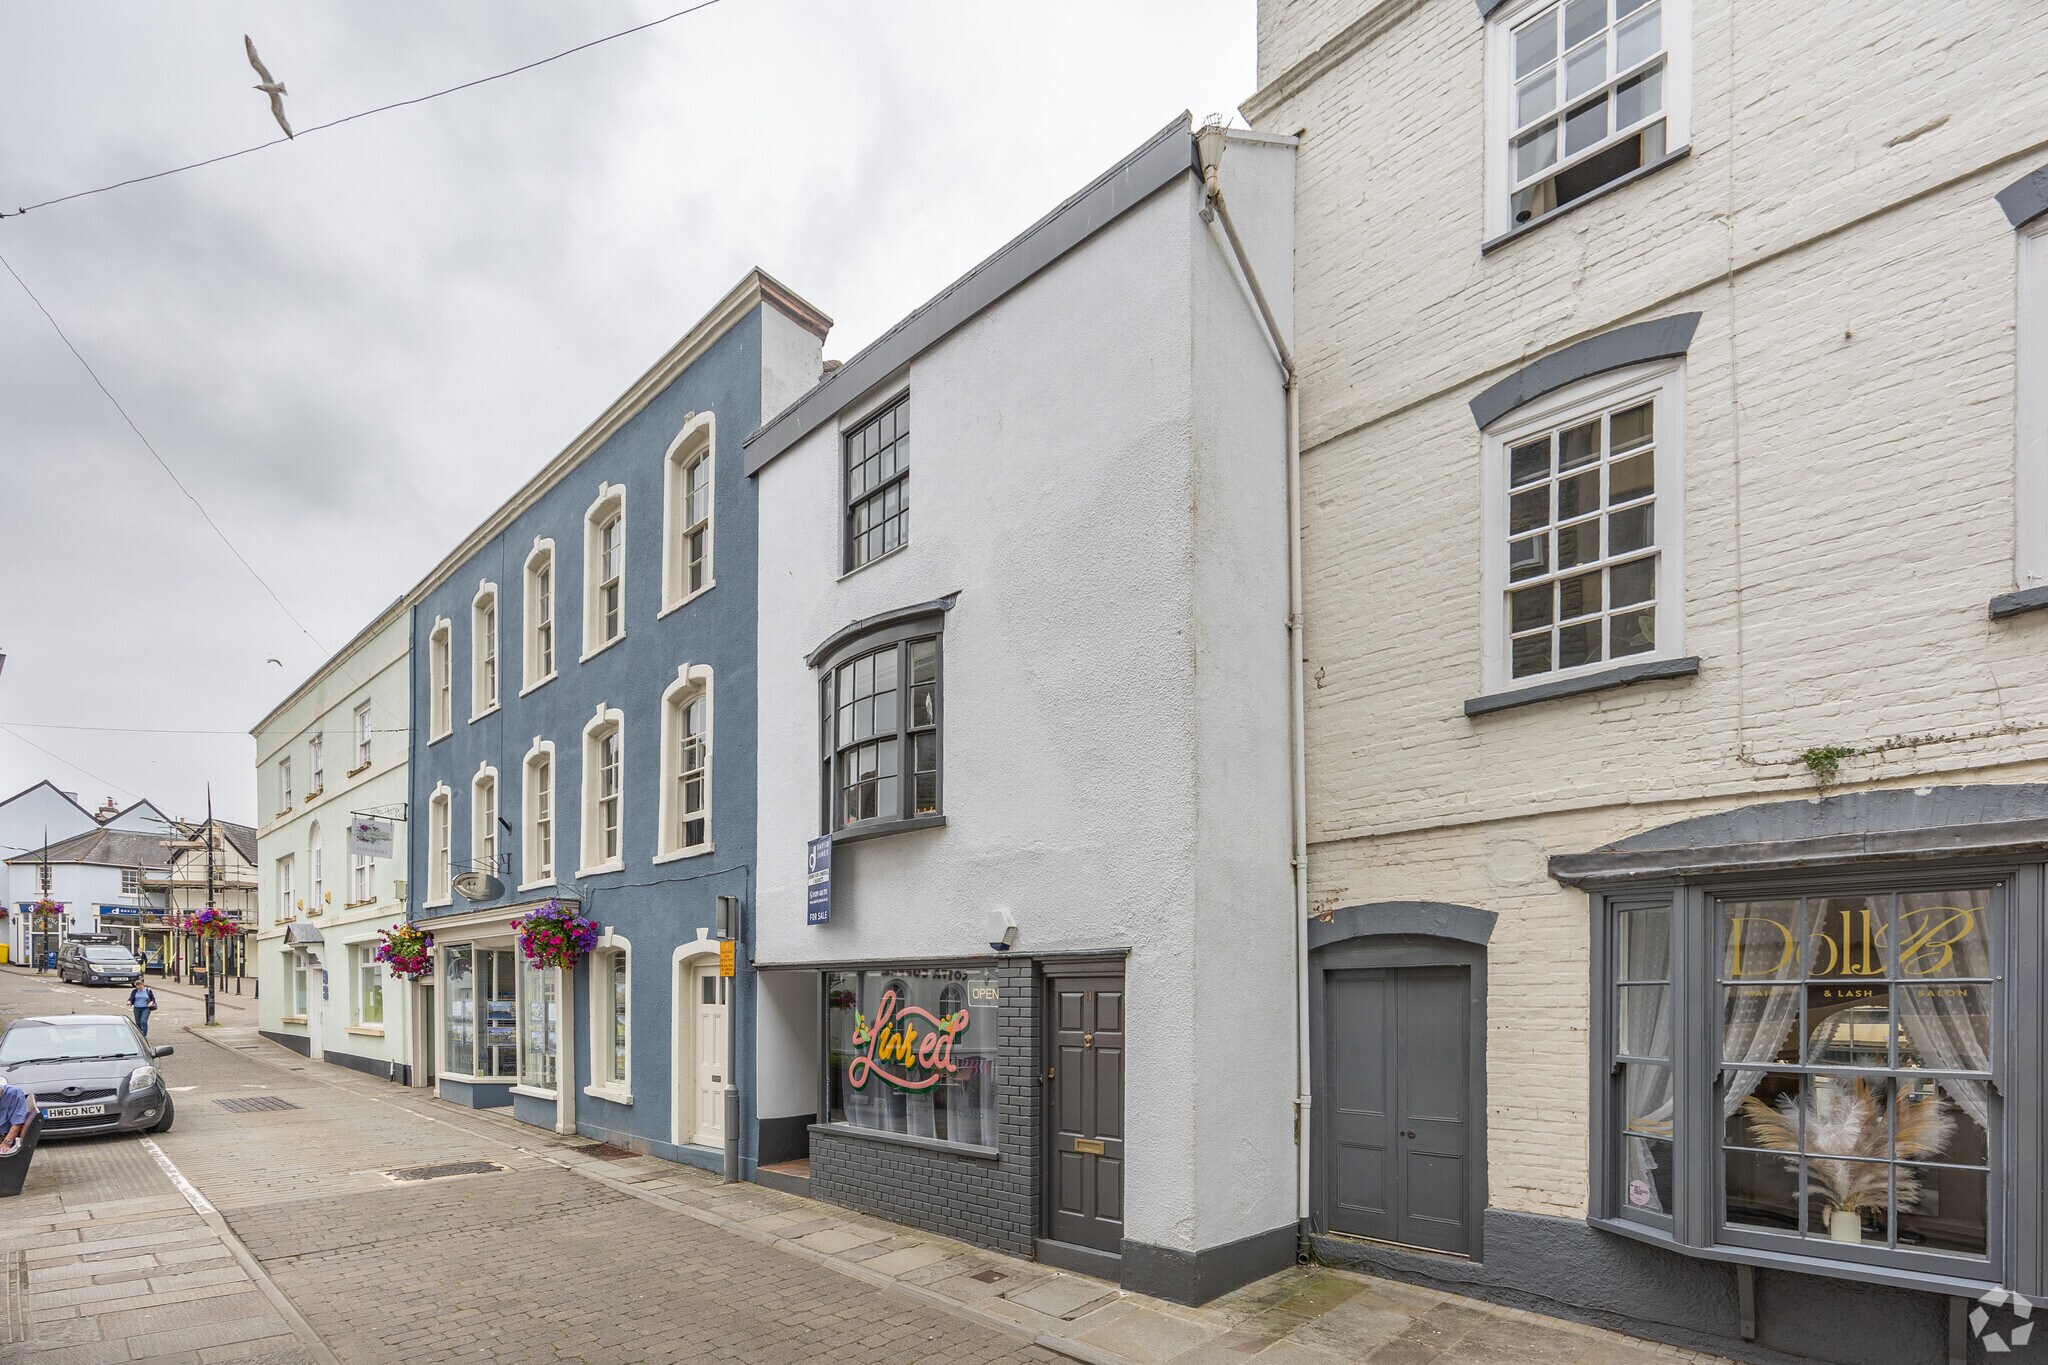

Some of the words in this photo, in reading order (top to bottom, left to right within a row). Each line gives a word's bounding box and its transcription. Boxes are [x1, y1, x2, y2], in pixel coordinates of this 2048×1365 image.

[810, 912, 818, 921] FOR
[818, 911, 828, 920] SALE
[972, 987, 999, 1000] OPEN
[1823, 990, 1832, 998] &
[1838, 989, 1873, 998] LASH
[1917, 989, 1969, 998] SALON
[49, 1107, 79, 1118] HW60
[81, 1106, 102, 1115] NCV
[952, 1107, 984, 1120] Studio
